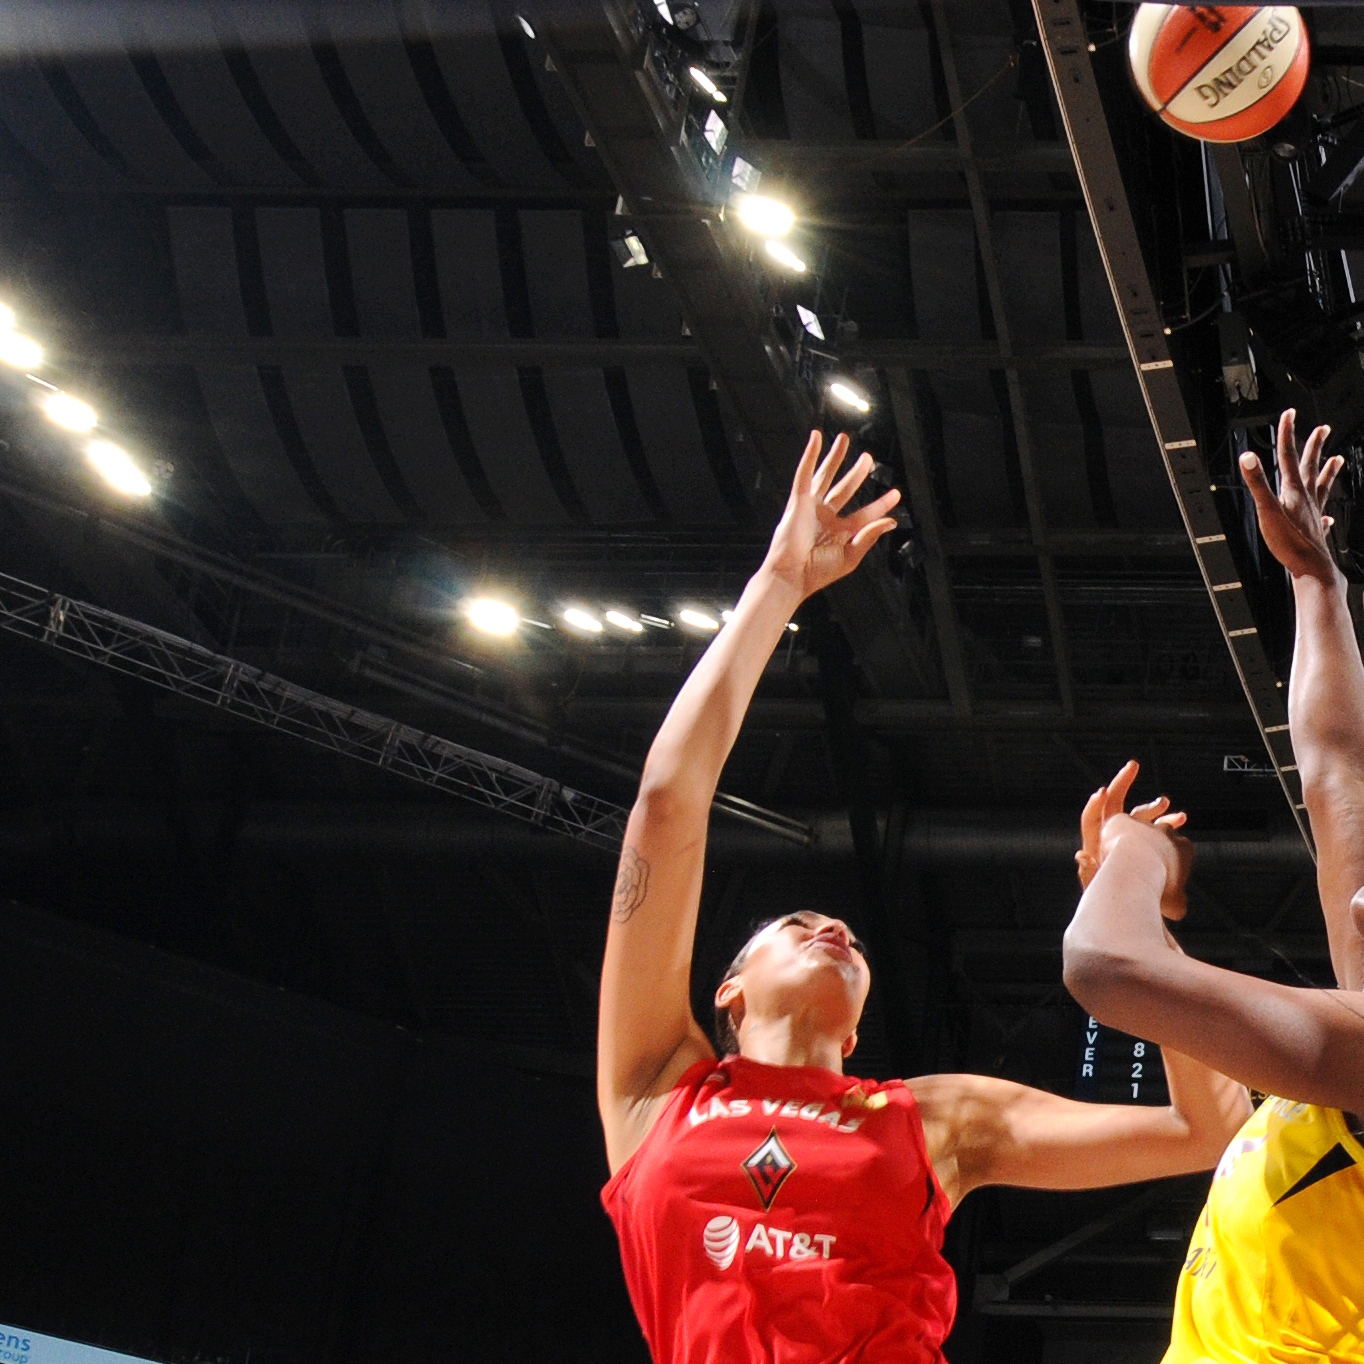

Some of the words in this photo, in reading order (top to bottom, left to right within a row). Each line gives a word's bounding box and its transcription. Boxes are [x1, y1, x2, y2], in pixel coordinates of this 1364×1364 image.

[1082, 1015, 1099, 1077] EVER
[1132, 1042, 1145, 1058] 8
[1131, 1062, 1142, 1078] 2
[1131, 1082, 1139, 1098] 1
[688, 1098, 752, 1127] LAS
[761, 1098, 864, 1133] VEGAS
[746, 1223, 836, 1261] AT&T
